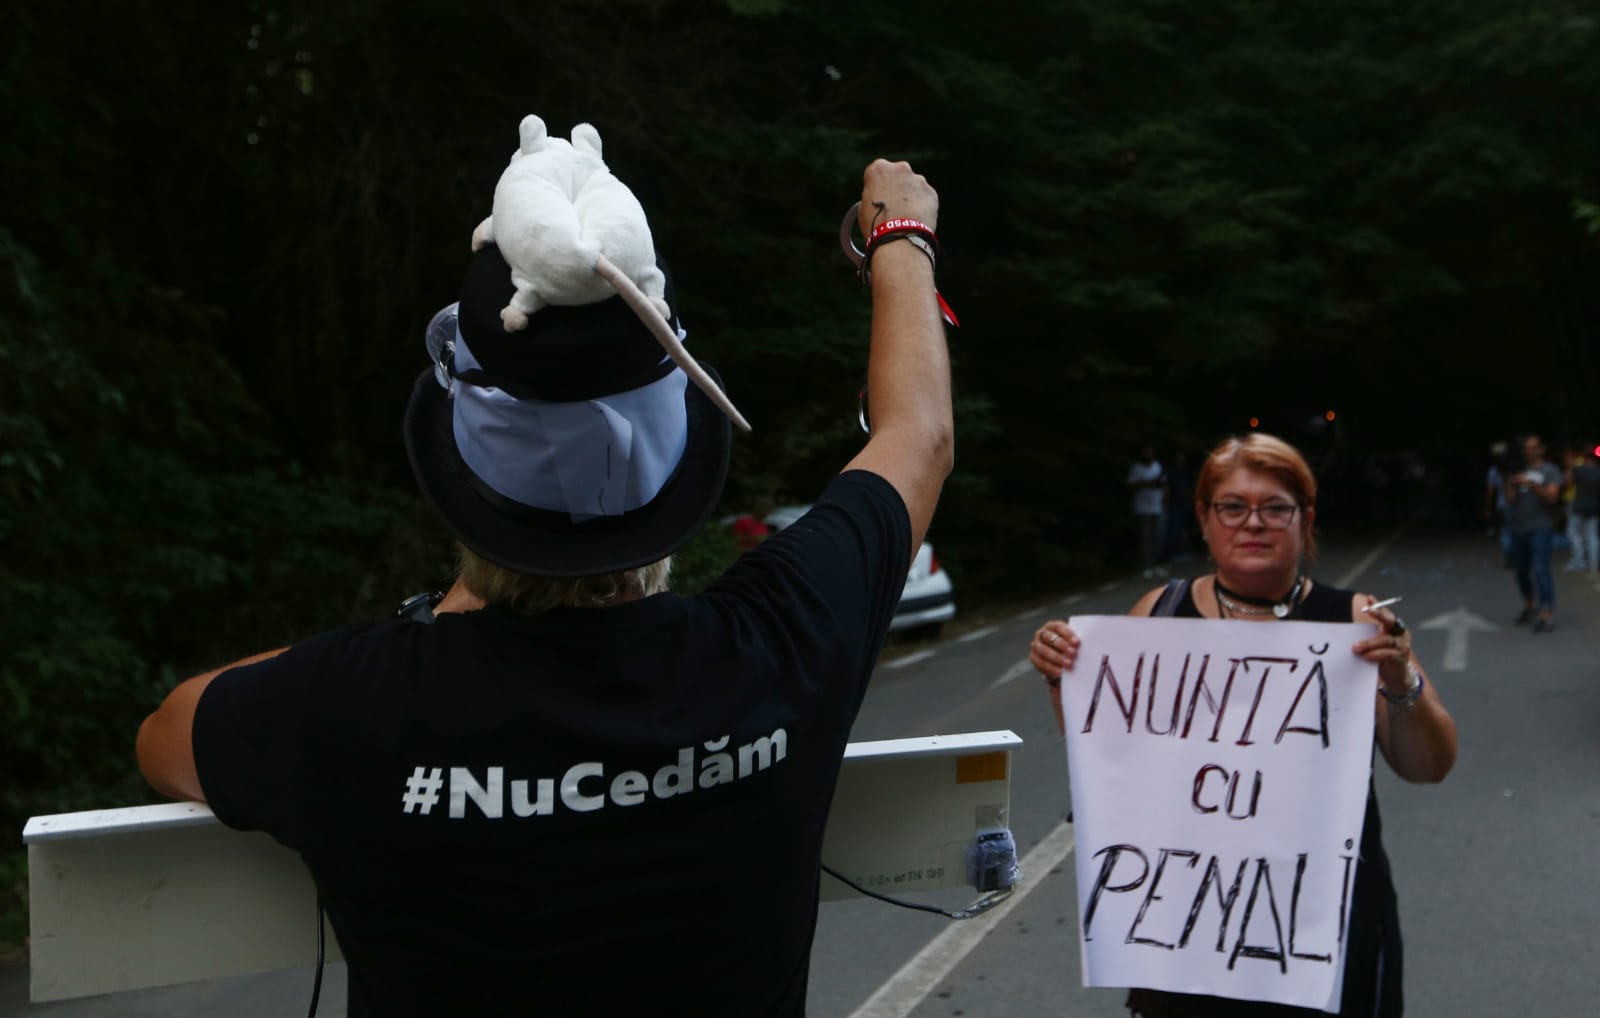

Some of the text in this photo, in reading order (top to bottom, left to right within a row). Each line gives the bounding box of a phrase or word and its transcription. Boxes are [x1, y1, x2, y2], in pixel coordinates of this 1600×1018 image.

[1081, 642, 1330, 749] NUNTĂ
[401, 727, 789, 820] #NuCedăm
[1192, 763, 1263, 820] CU
